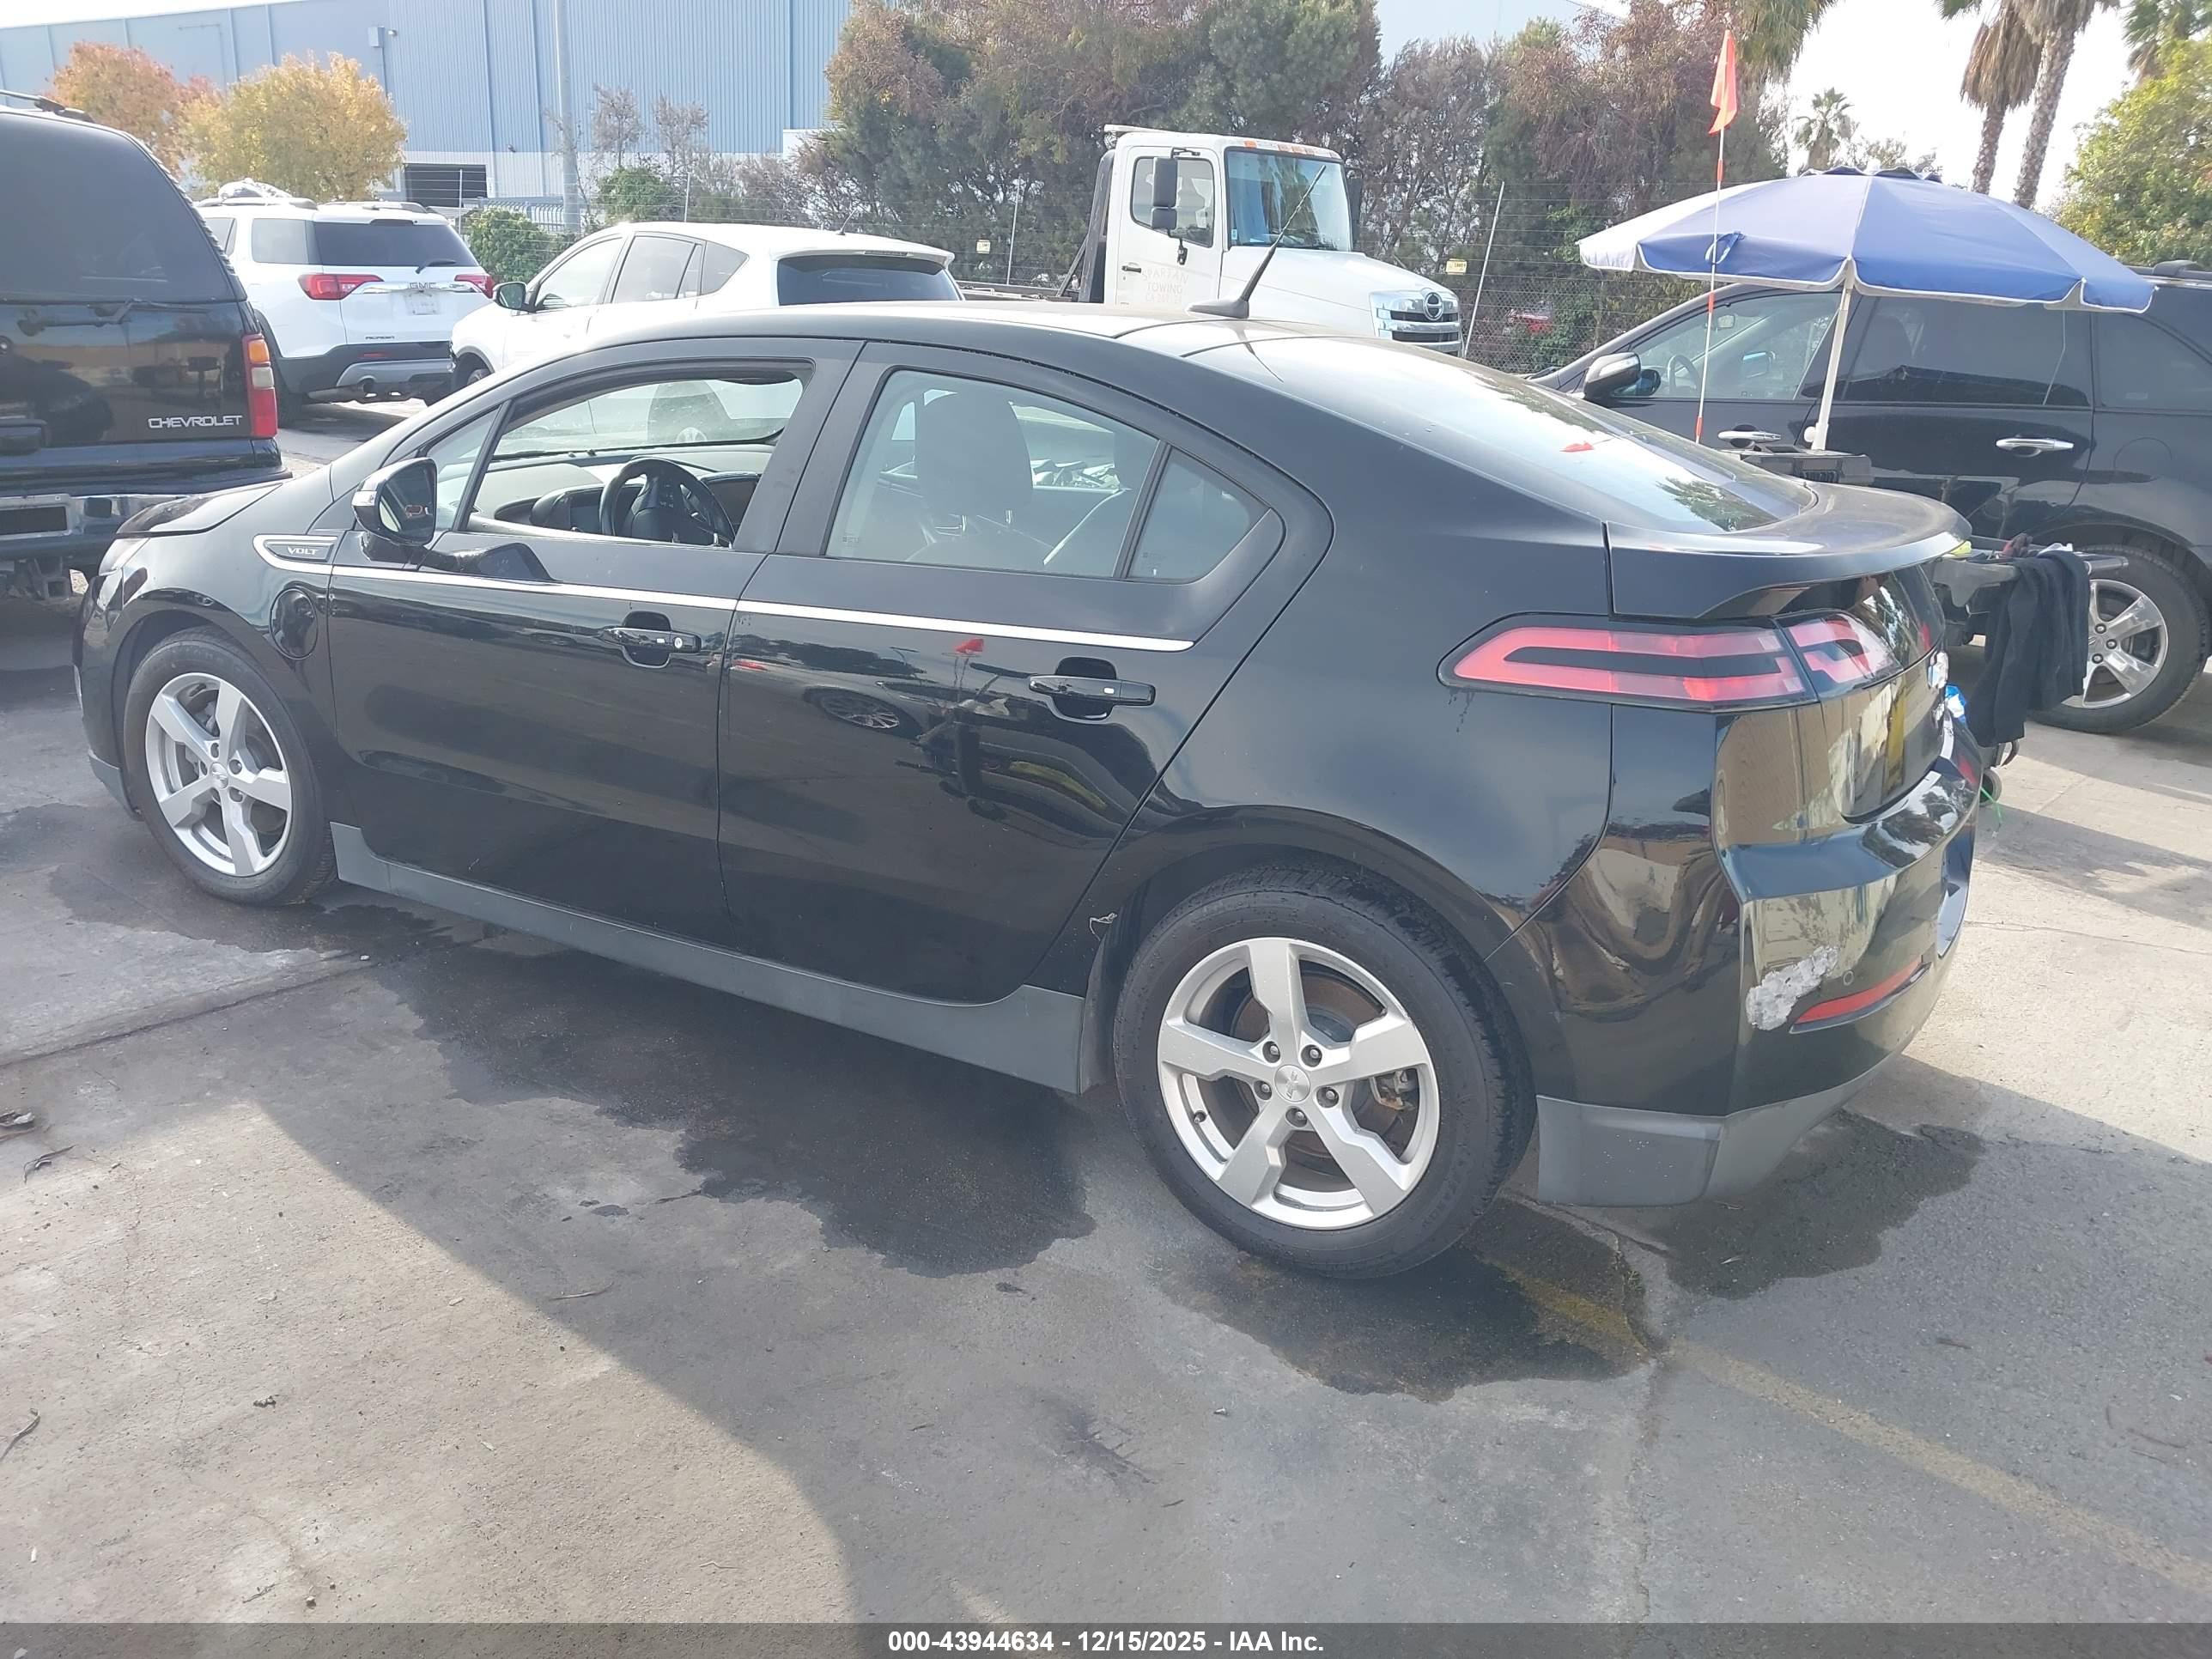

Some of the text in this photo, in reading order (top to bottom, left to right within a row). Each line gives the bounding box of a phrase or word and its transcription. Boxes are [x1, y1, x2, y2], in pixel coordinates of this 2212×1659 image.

[1142, 267, 1188, 284] SPARTAN
[1147, 282, 1183, 295] TOWING
[148, 415, 243, 428] CHEVROLET
[287, 545, 319, 556] VOLT
